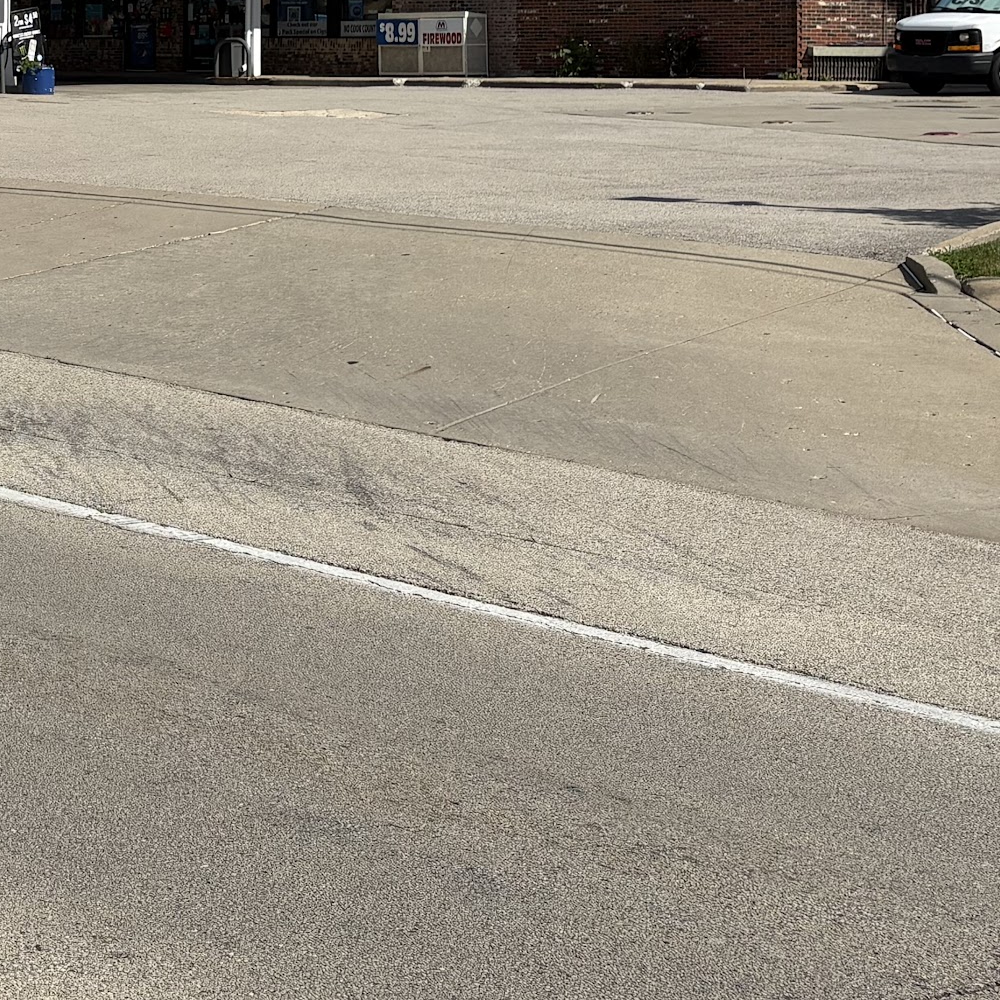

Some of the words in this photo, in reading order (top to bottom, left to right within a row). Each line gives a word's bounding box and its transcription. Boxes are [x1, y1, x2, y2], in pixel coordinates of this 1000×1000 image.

[362, 24, 376, 33] COUNT
[380, 22, 416, 43] $8.99
[422, 32, 462, 45] FIREWOOD
